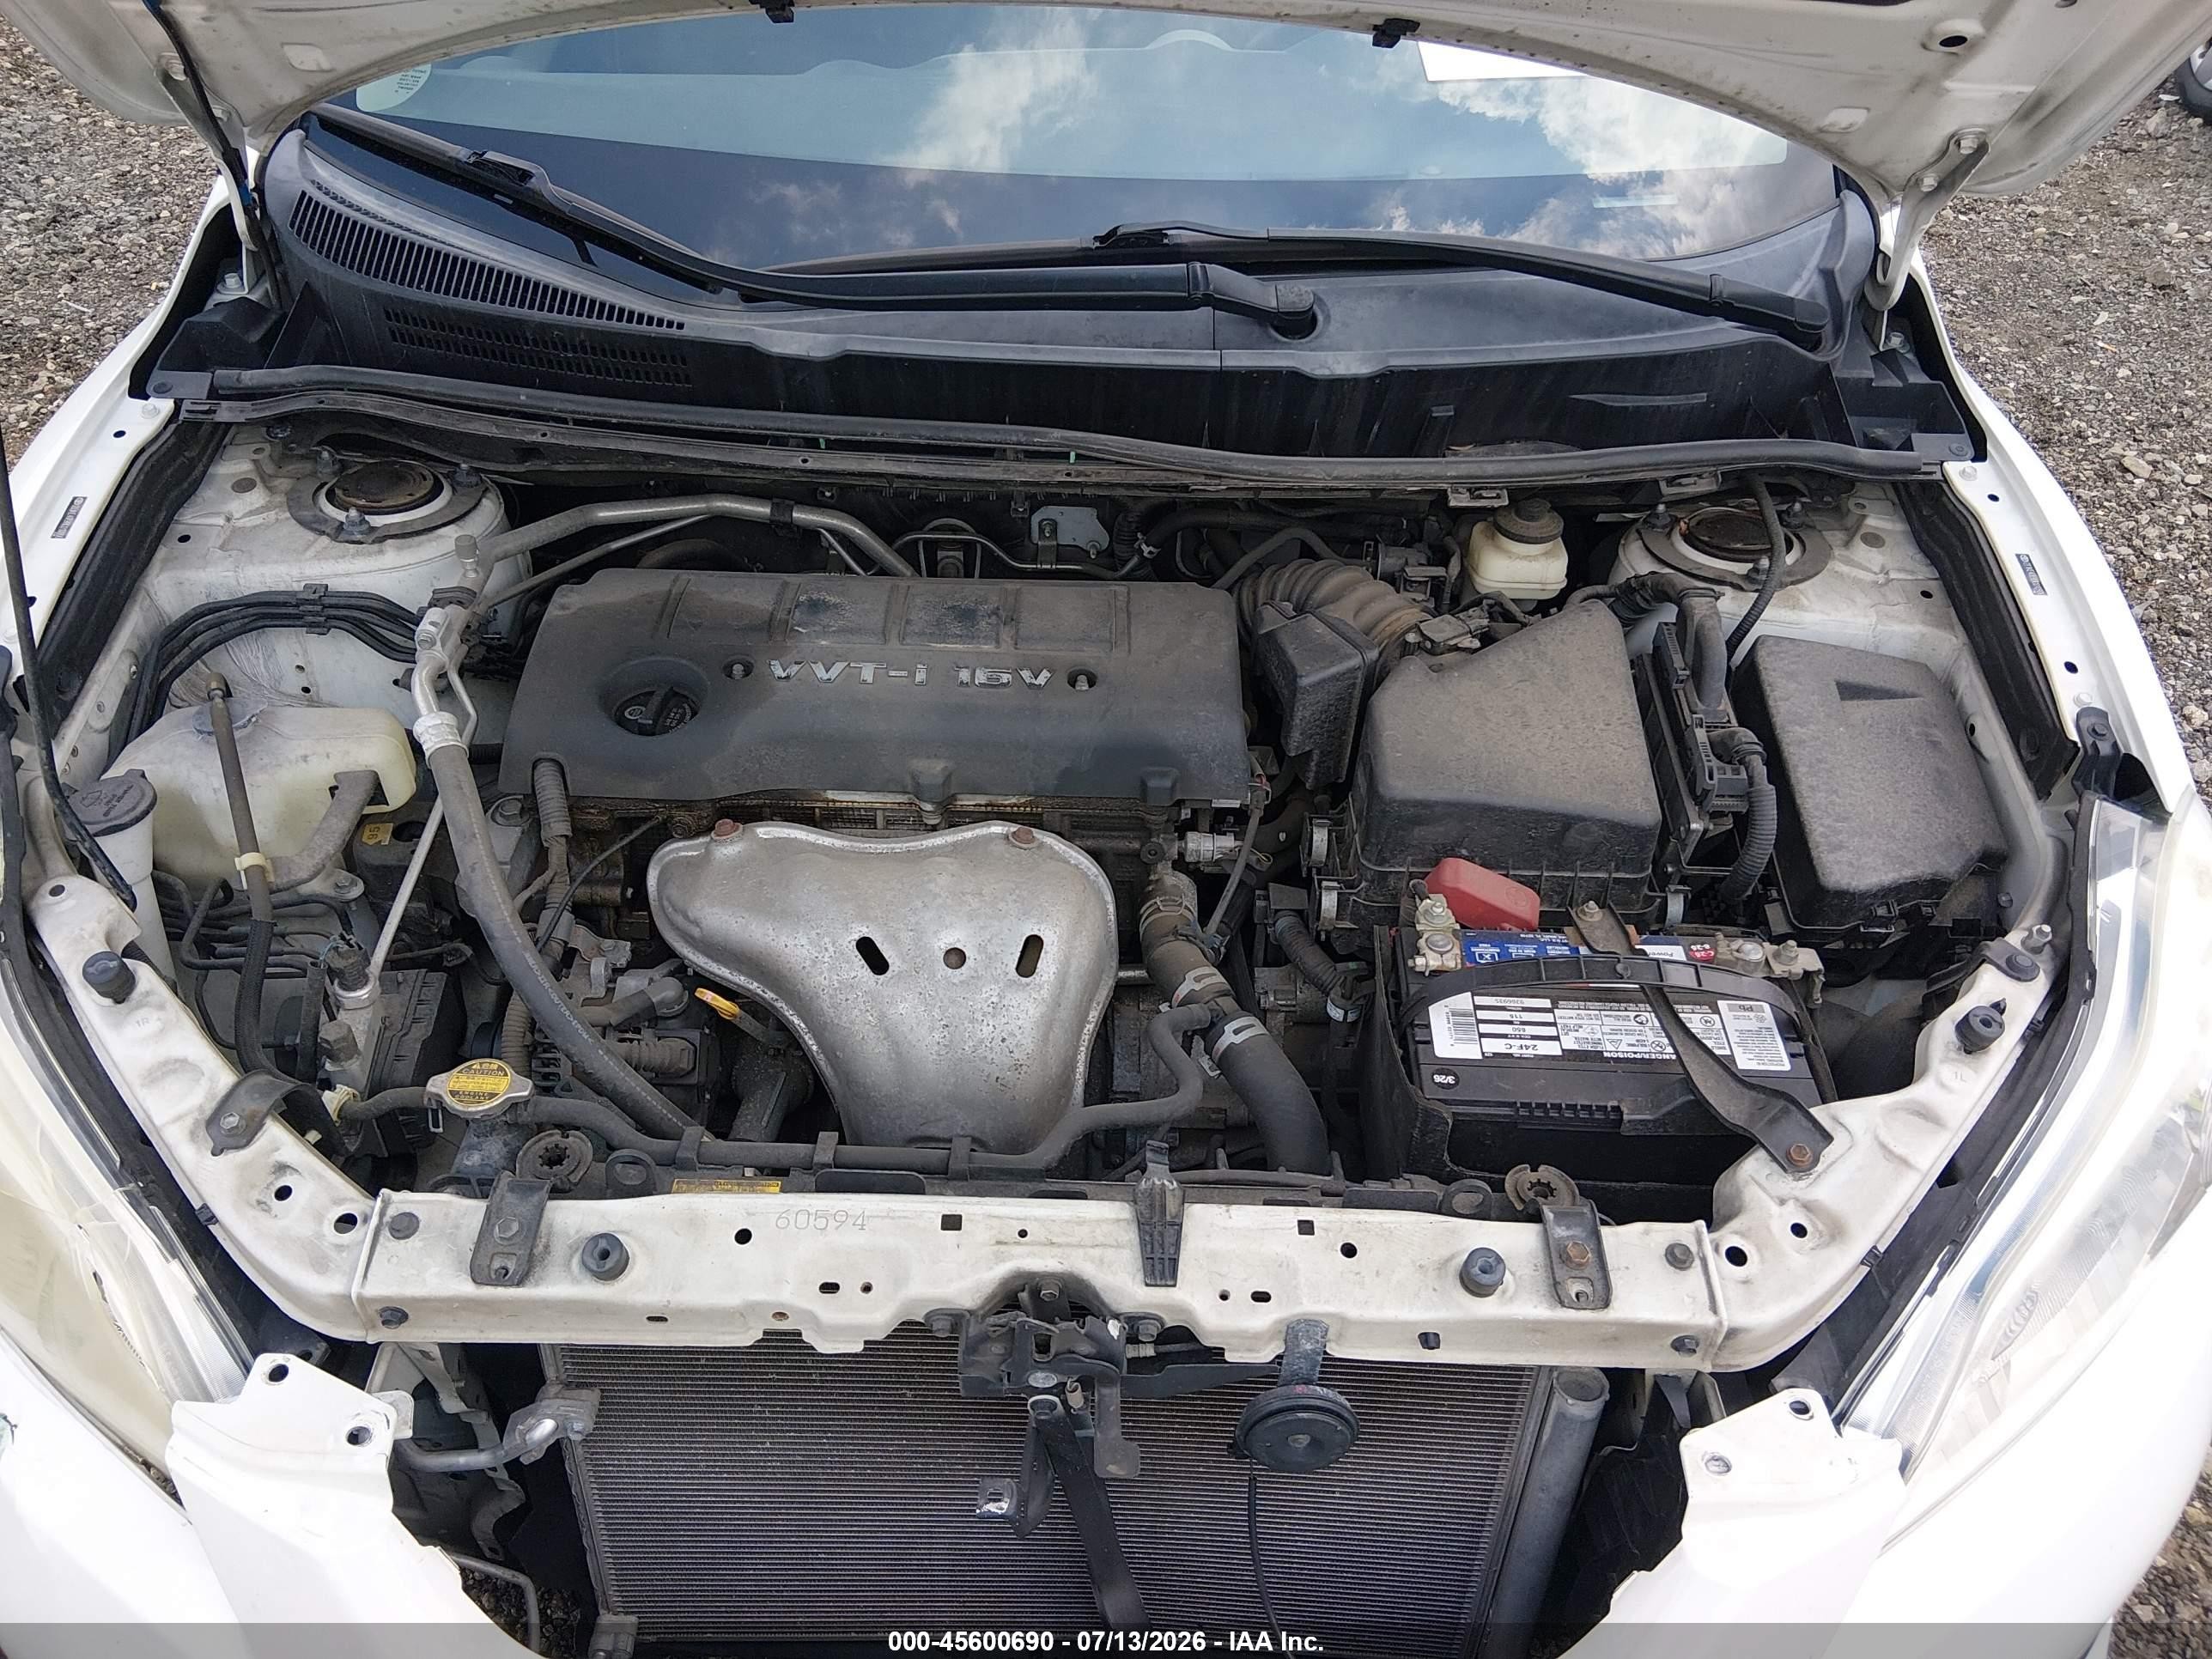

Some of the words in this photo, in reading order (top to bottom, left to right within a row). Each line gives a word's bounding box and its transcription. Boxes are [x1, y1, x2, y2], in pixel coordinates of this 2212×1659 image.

[767, 659, 927, 686] VVT-i
[954, 665, 1054, 690] 16V
[368, 826, 380, 840] 95
[1504, 1042, 1539, 1051] 24F-C
[1602, 1051, 1677, 1060] ANGER/POISON
[1433, 1074, 1455, 1085] 3/26
[775, 1208, 866, 1231] 60594
